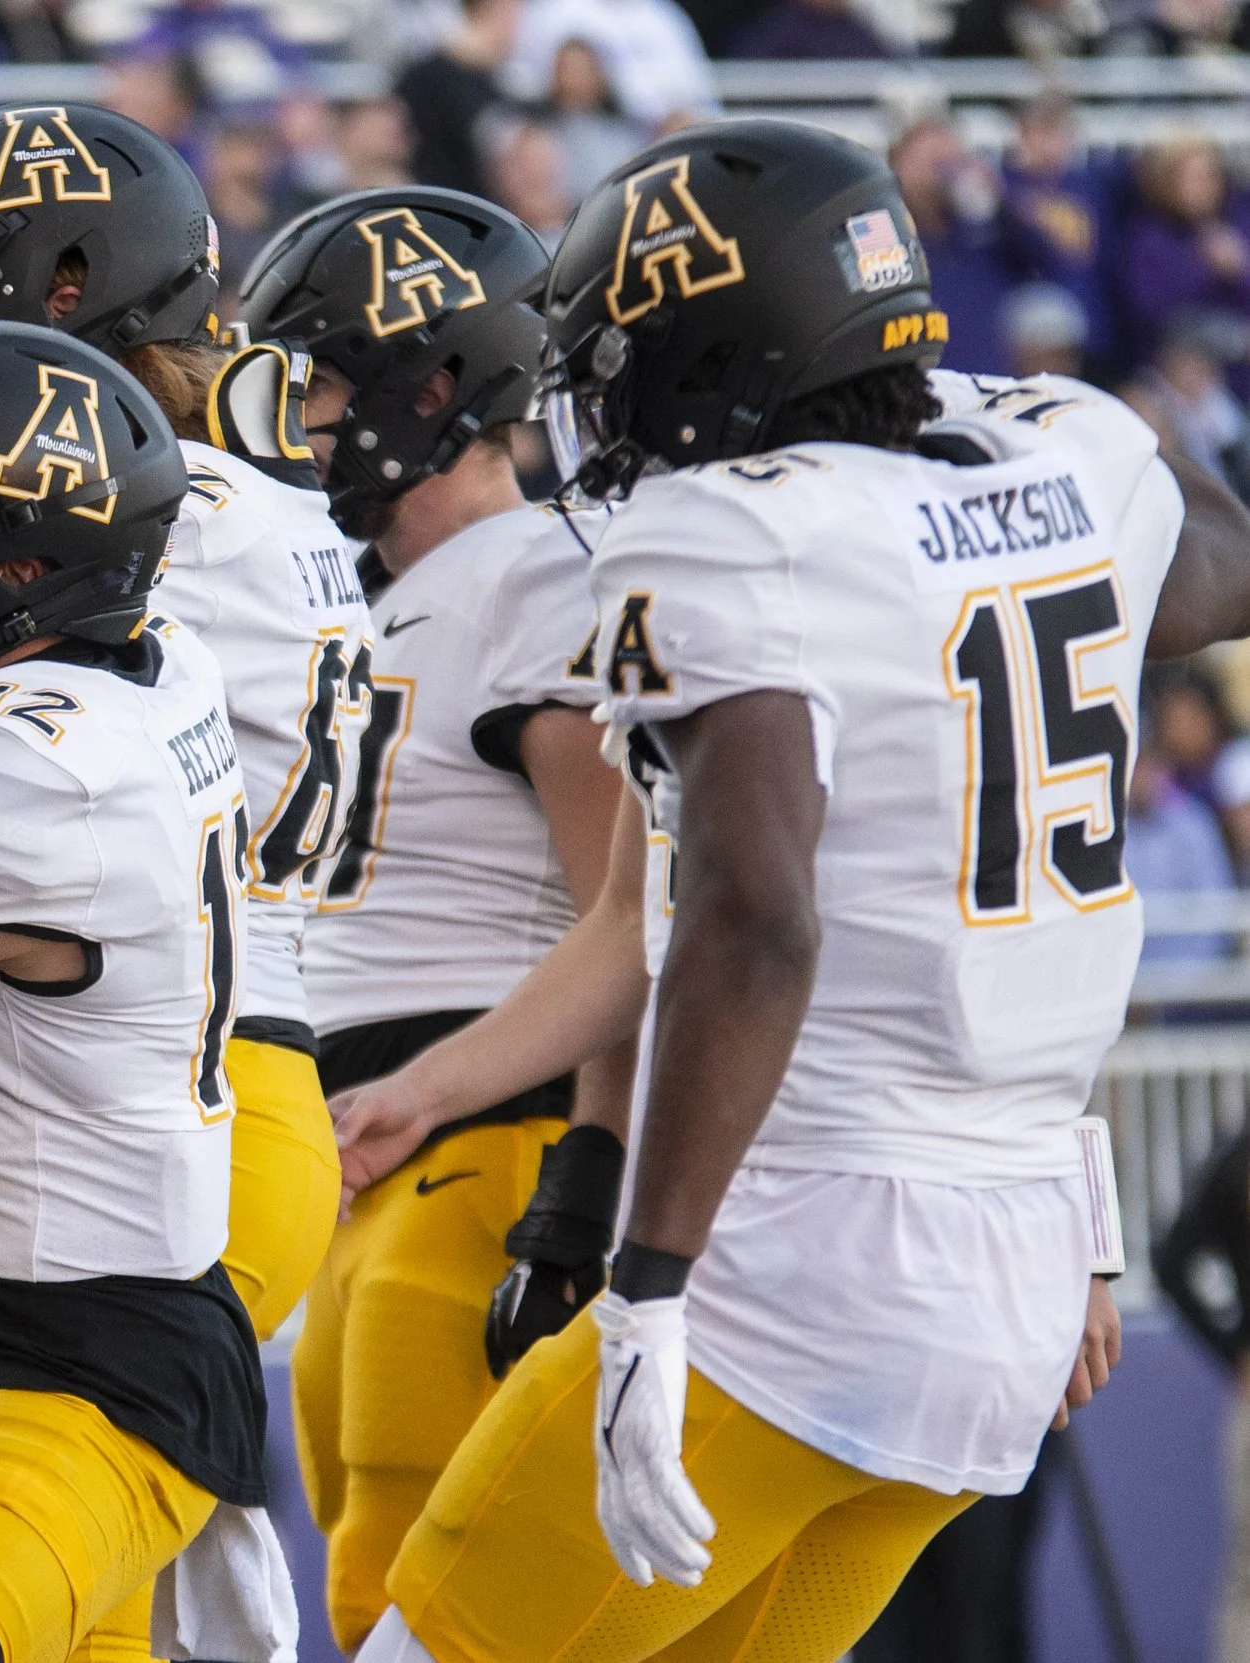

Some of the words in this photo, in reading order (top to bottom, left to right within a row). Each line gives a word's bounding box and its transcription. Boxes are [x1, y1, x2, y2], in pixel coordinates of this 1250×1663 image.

[12, 147, 76, 162] Mountaineers
[355, 207, 488, 338] A
[606, 154, 746, 327] A
[34, 433, 96, 465] Mountaineers
[918, 473, 1096, 564] JACKSON
[608, 588, 675, 698] A
[942, 558, 1138, 927] 15
[190, 788, 250, 1127] 1
